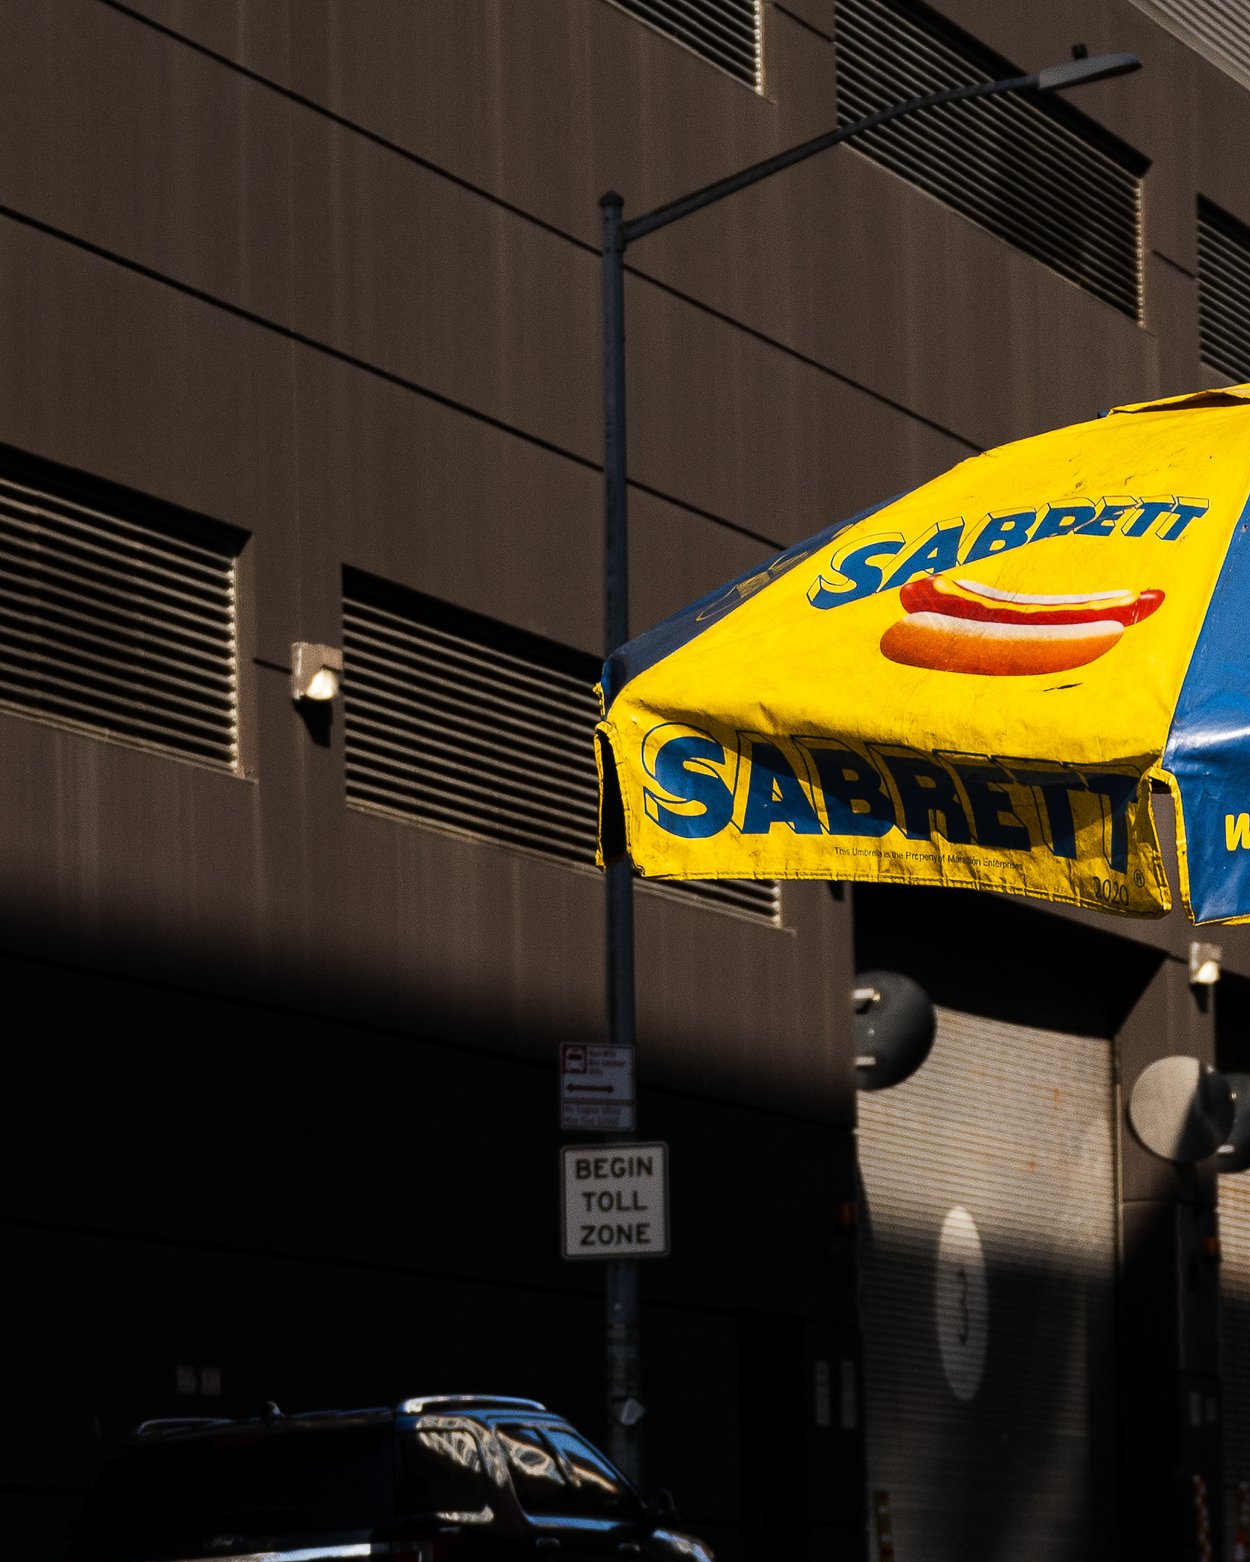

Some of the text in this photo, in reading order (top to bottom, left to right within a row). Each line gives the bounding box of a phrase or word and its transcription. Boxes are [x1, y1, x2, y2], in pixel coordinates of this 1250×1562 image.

[807, 494, 1209, 610] SABRETT
[641, 722, 1143, 875] SABRETT
[1092, 875, 1130, 907] 2020
[576, 1157, 654, 1180] BEGIN
[581, 1190, 649, 1213] TOLL
[579, 1223, 652, 1246] ZONE
